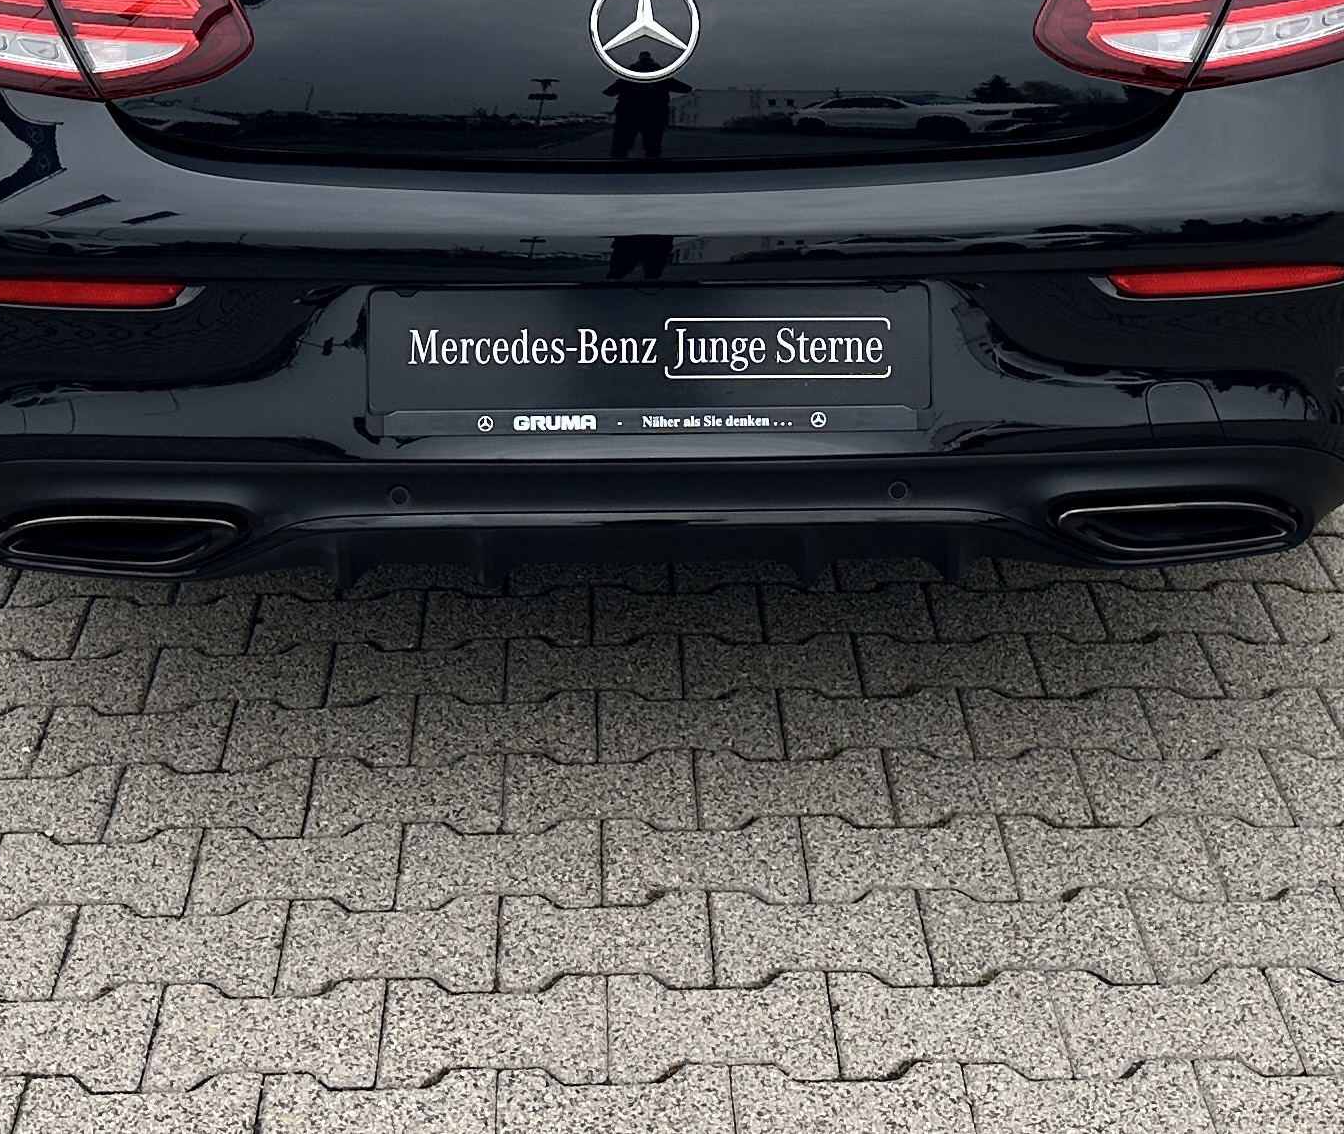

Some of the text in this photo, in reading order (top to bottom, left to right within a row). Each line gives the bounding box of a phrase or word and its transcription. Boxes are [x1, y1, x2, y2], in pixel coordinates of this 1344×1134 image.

[408, 327, 883, 372] Mercedes-Benz Junge Sterne
[513, 415, 597, 431] GRUMA
[642, 416, 681, 428] Näher
[683, 415, 701, 428] als
[703, 415, 723, 427] Sie
[725, 415, 770, 427] denken
